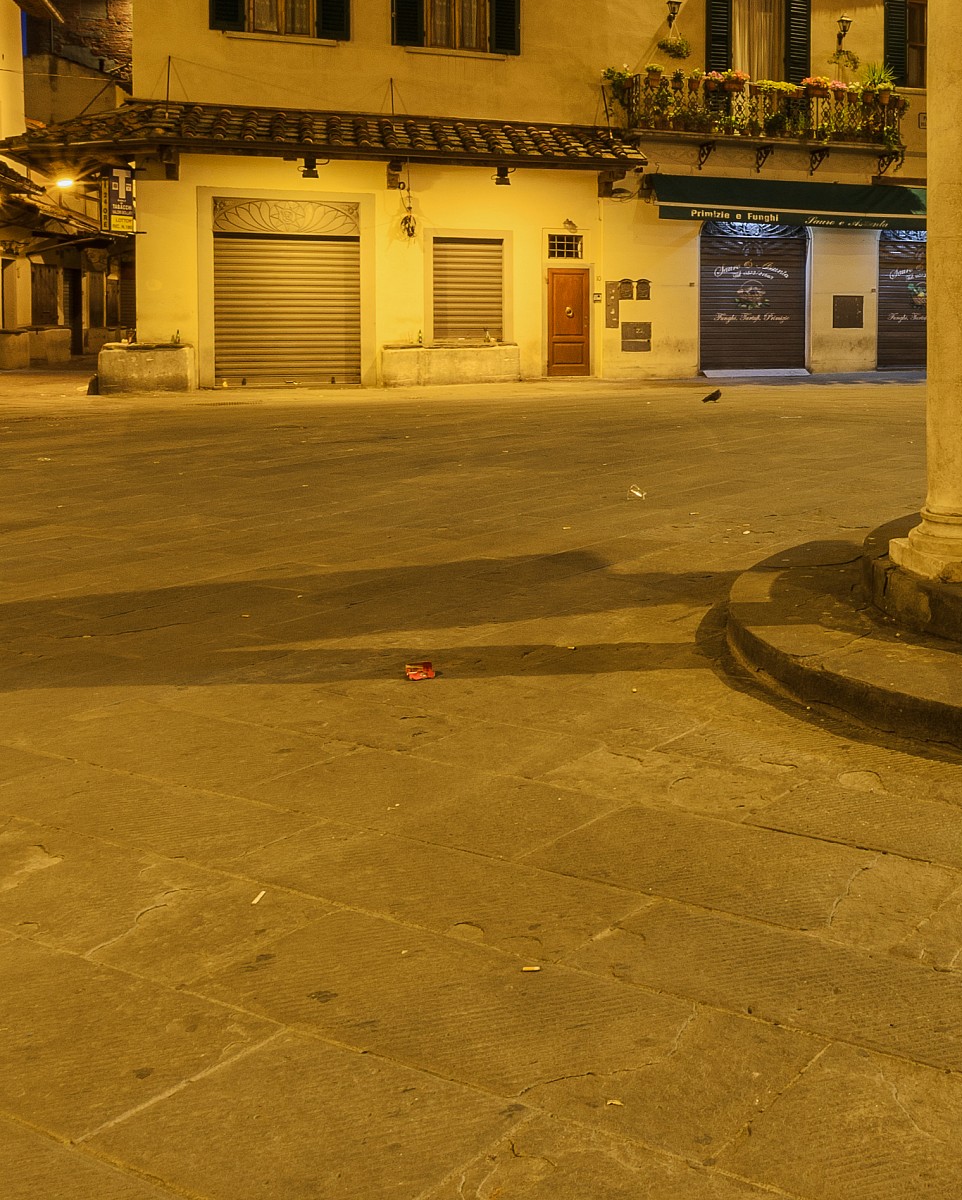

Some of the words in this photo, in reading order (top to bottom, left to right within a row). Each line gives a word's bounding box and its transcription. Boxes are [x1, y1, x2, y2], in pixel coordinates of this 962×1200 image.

[691, 209, 730, 219] Primizie
[747, 212, 779, 222] Funghi
[848, 219, 889, 228] Asnta
